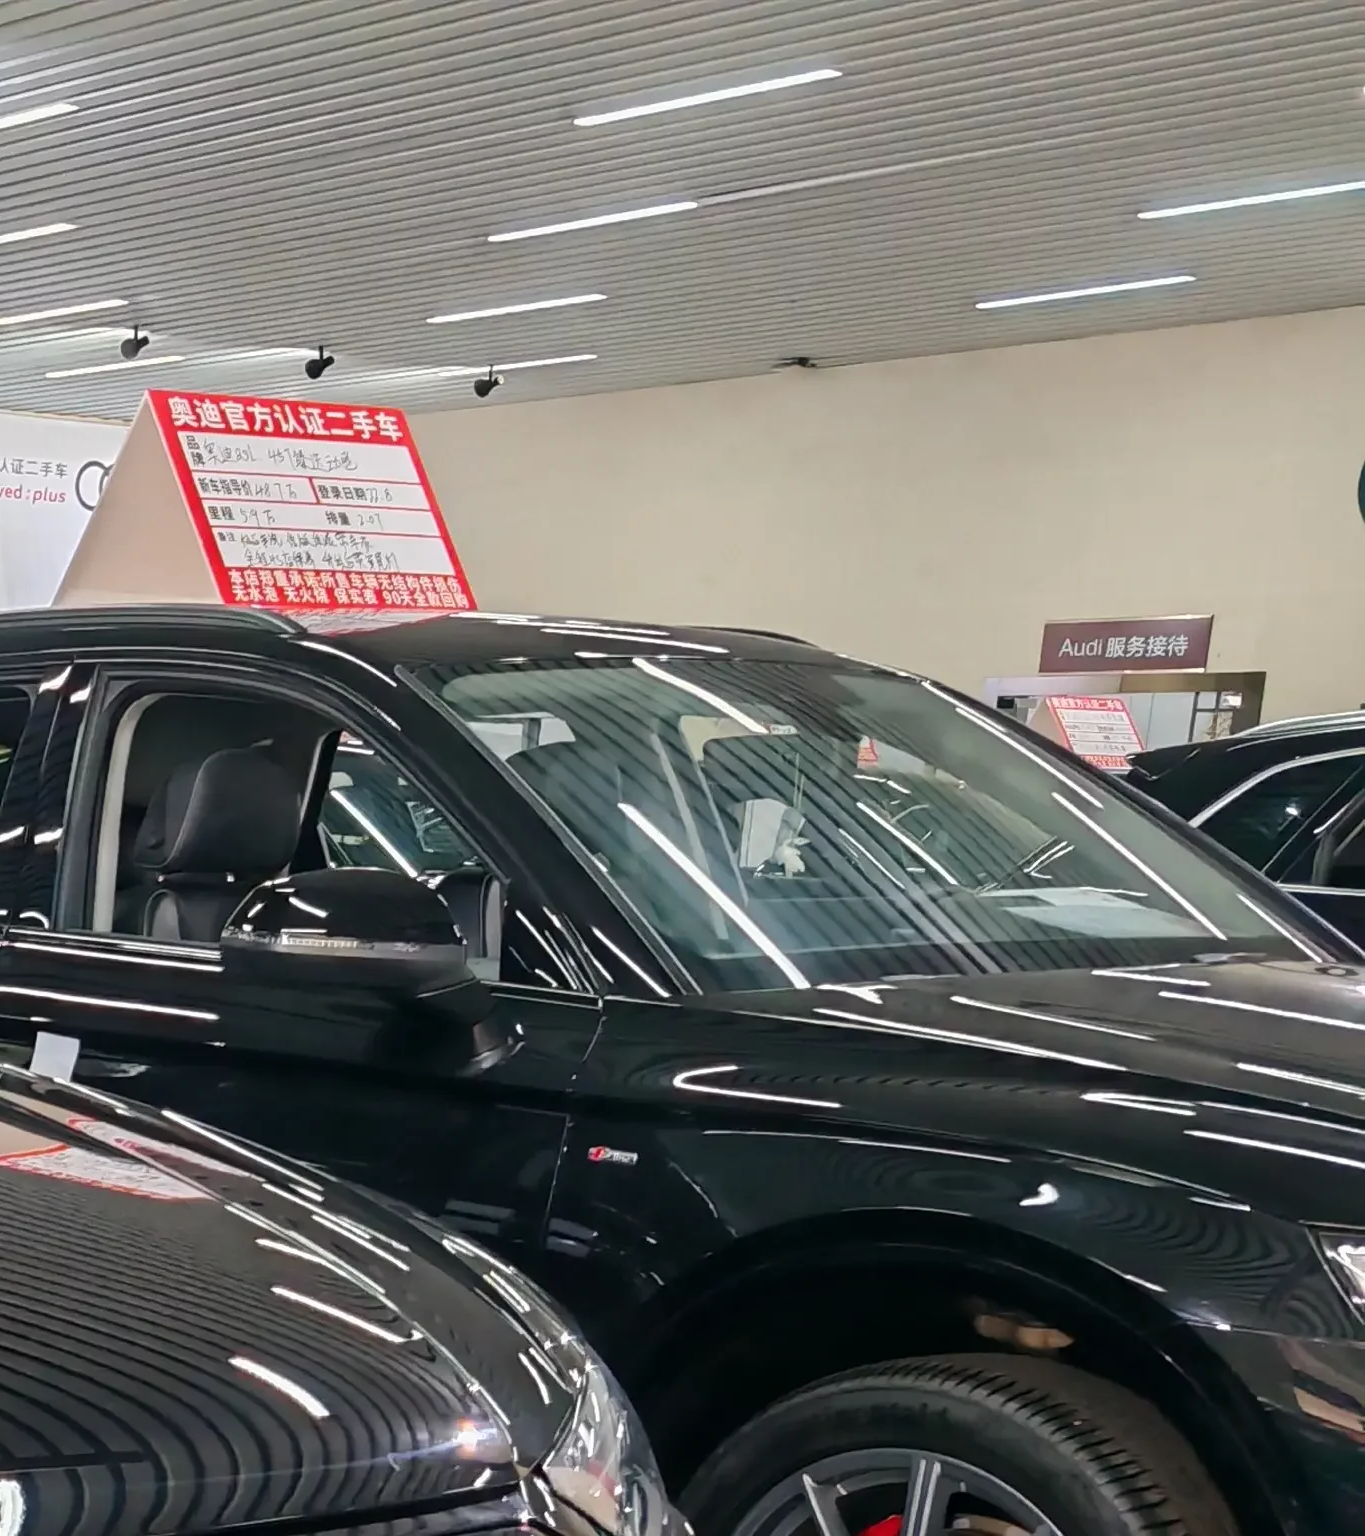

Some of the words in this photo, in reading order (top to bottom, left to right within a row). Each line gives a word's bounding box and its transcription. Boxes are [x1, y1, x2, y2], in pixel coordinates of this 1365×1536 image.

[167, 396, 404, 442] 奥迪官方认证二手车
[197, 476, 253, 497] 新车指导价
[207, 505, 235, 521] 里程
[324, 510, 351, 526] 排量
[1058, 637, 1103, 658] Audi
[1104, 634, 1189, 659] 服务接待
